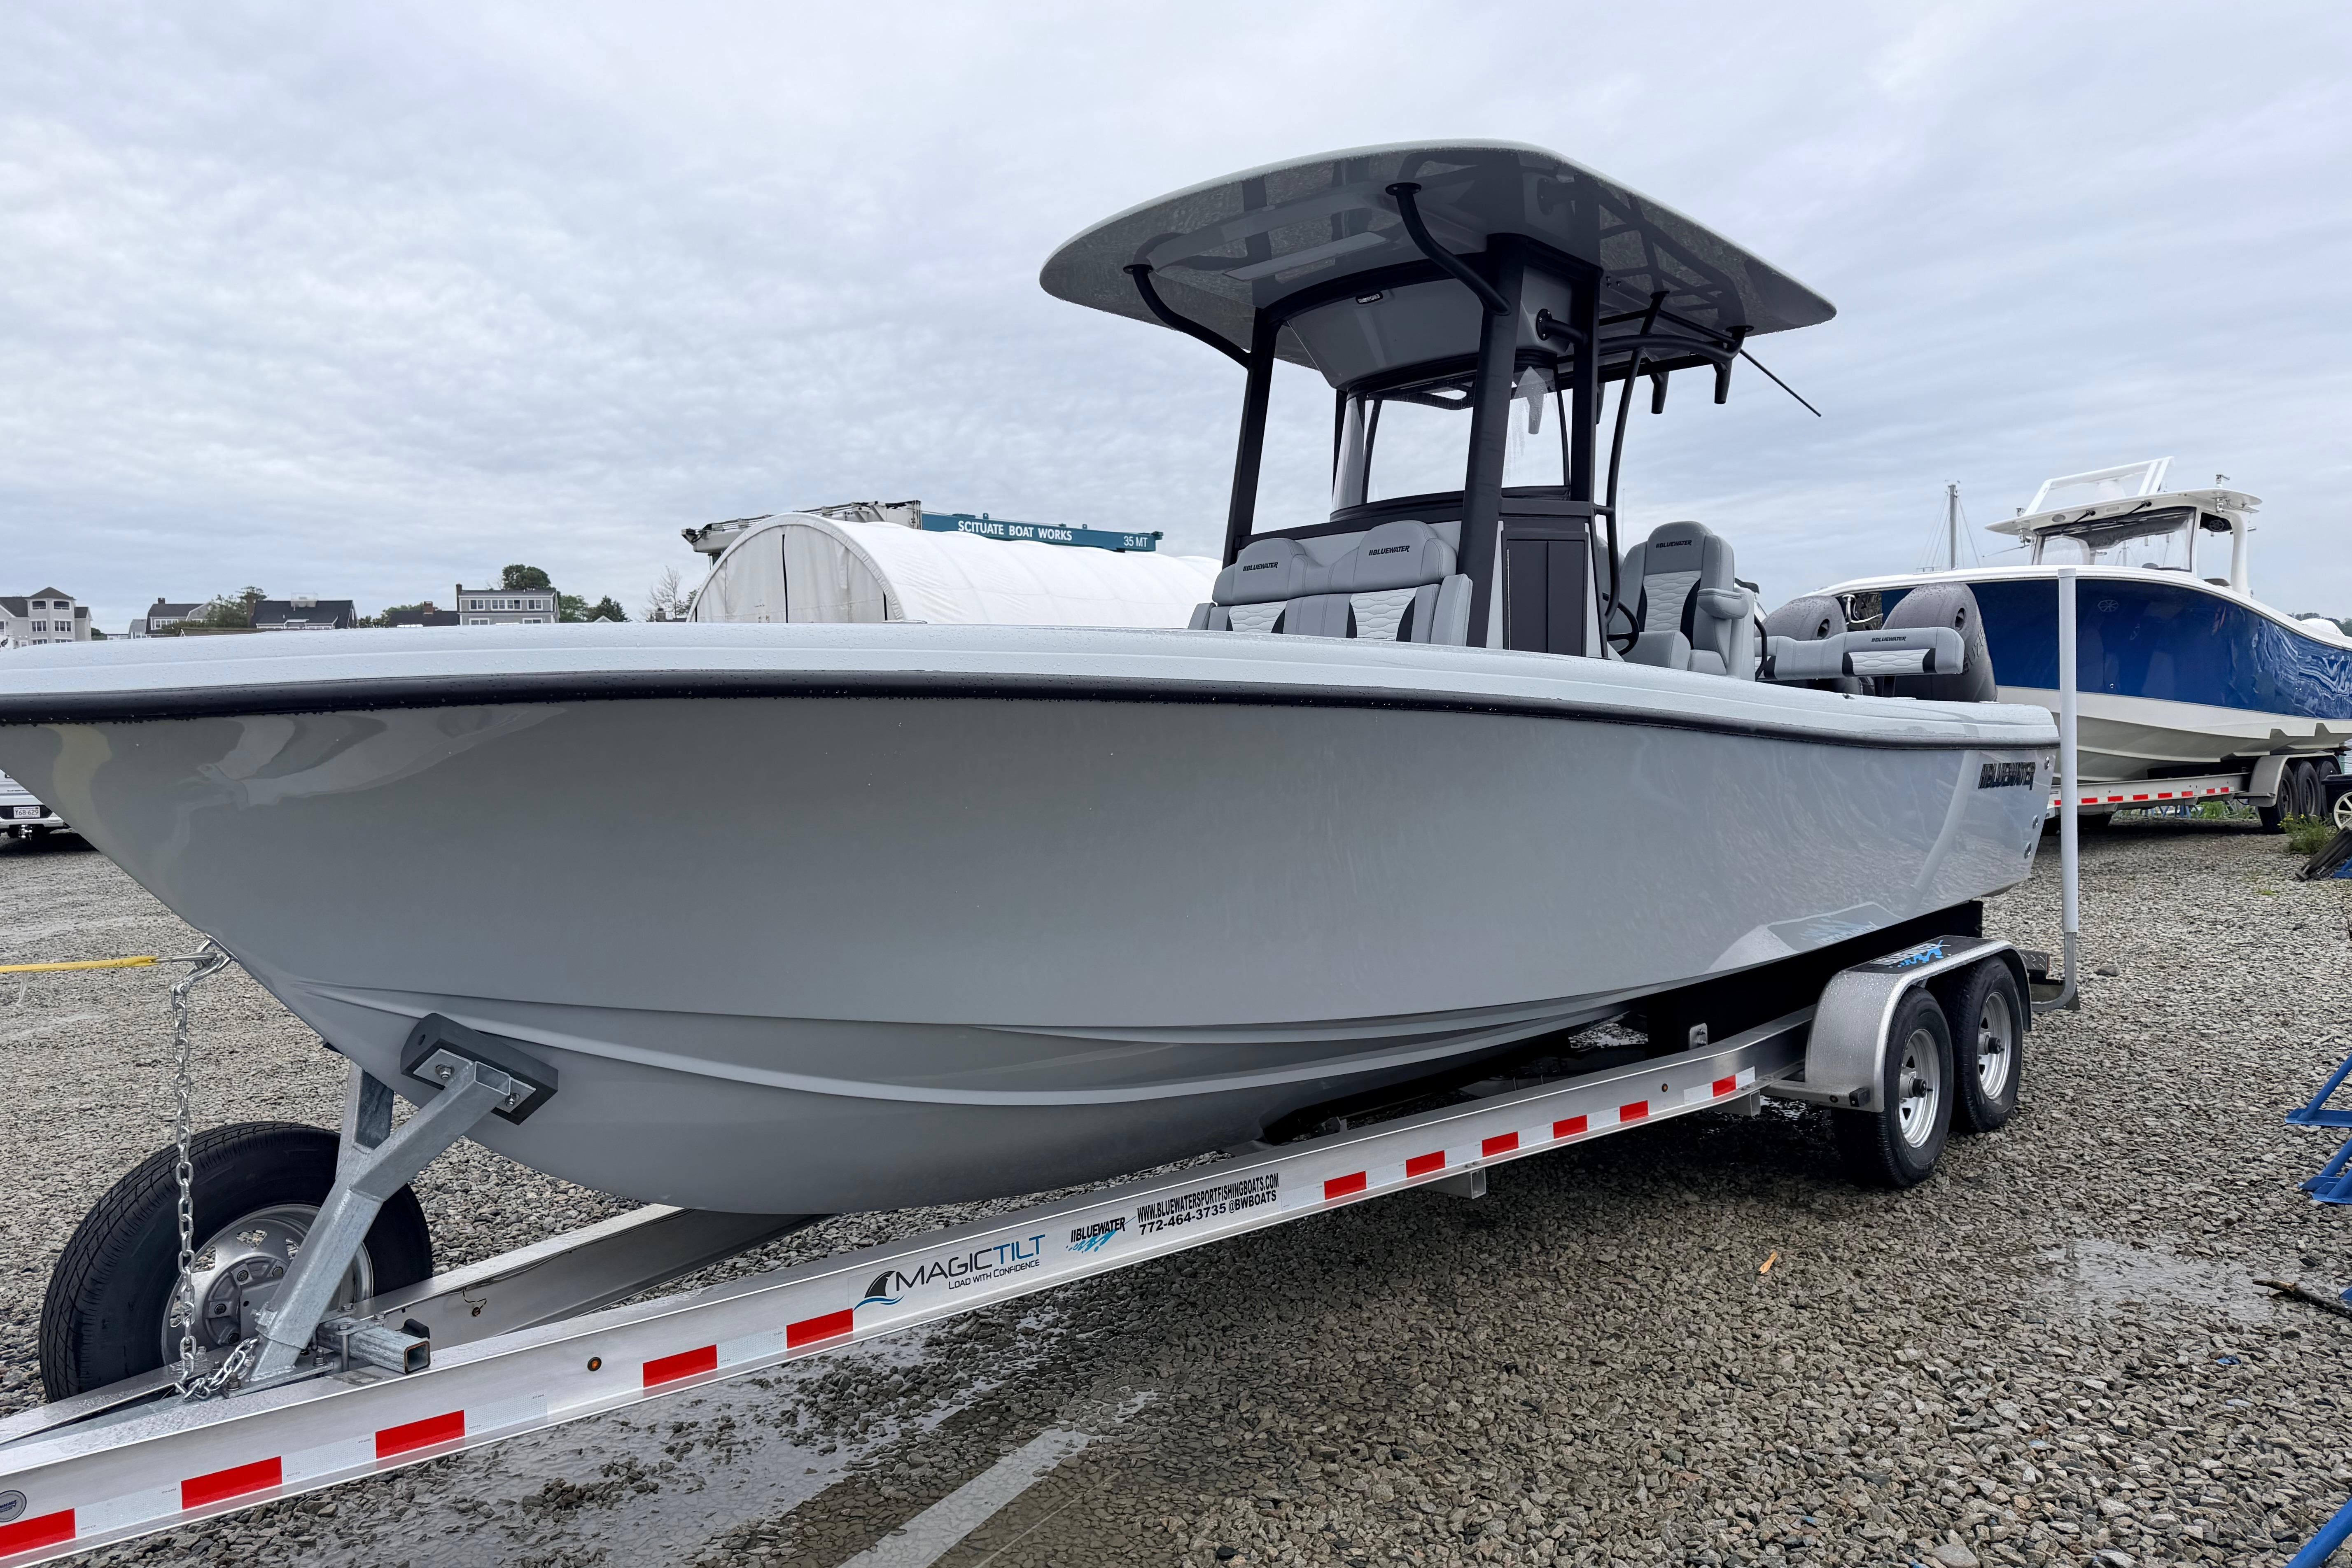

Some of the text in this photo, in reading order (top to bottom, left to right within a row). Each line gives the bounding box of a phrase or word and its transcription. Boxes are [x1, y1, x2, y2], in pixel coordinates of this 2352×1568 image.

[958, 520, 1072, 541] SCITUATE BOAT WORKS
[1123, 536, 1148, 548] 35 MT
[1137, 1173, 1279, 1223] WWW.BLUEWATERSPORTFISHINGBOATS.COM
[1139, 1190, 1276, 1235] 772-464-3735 @BWBOATS
[896, 1234, 1045, 1291] MAGICTILT
[949, 1259, 1040, 1290] LOAD WITH CONFIDENCE
